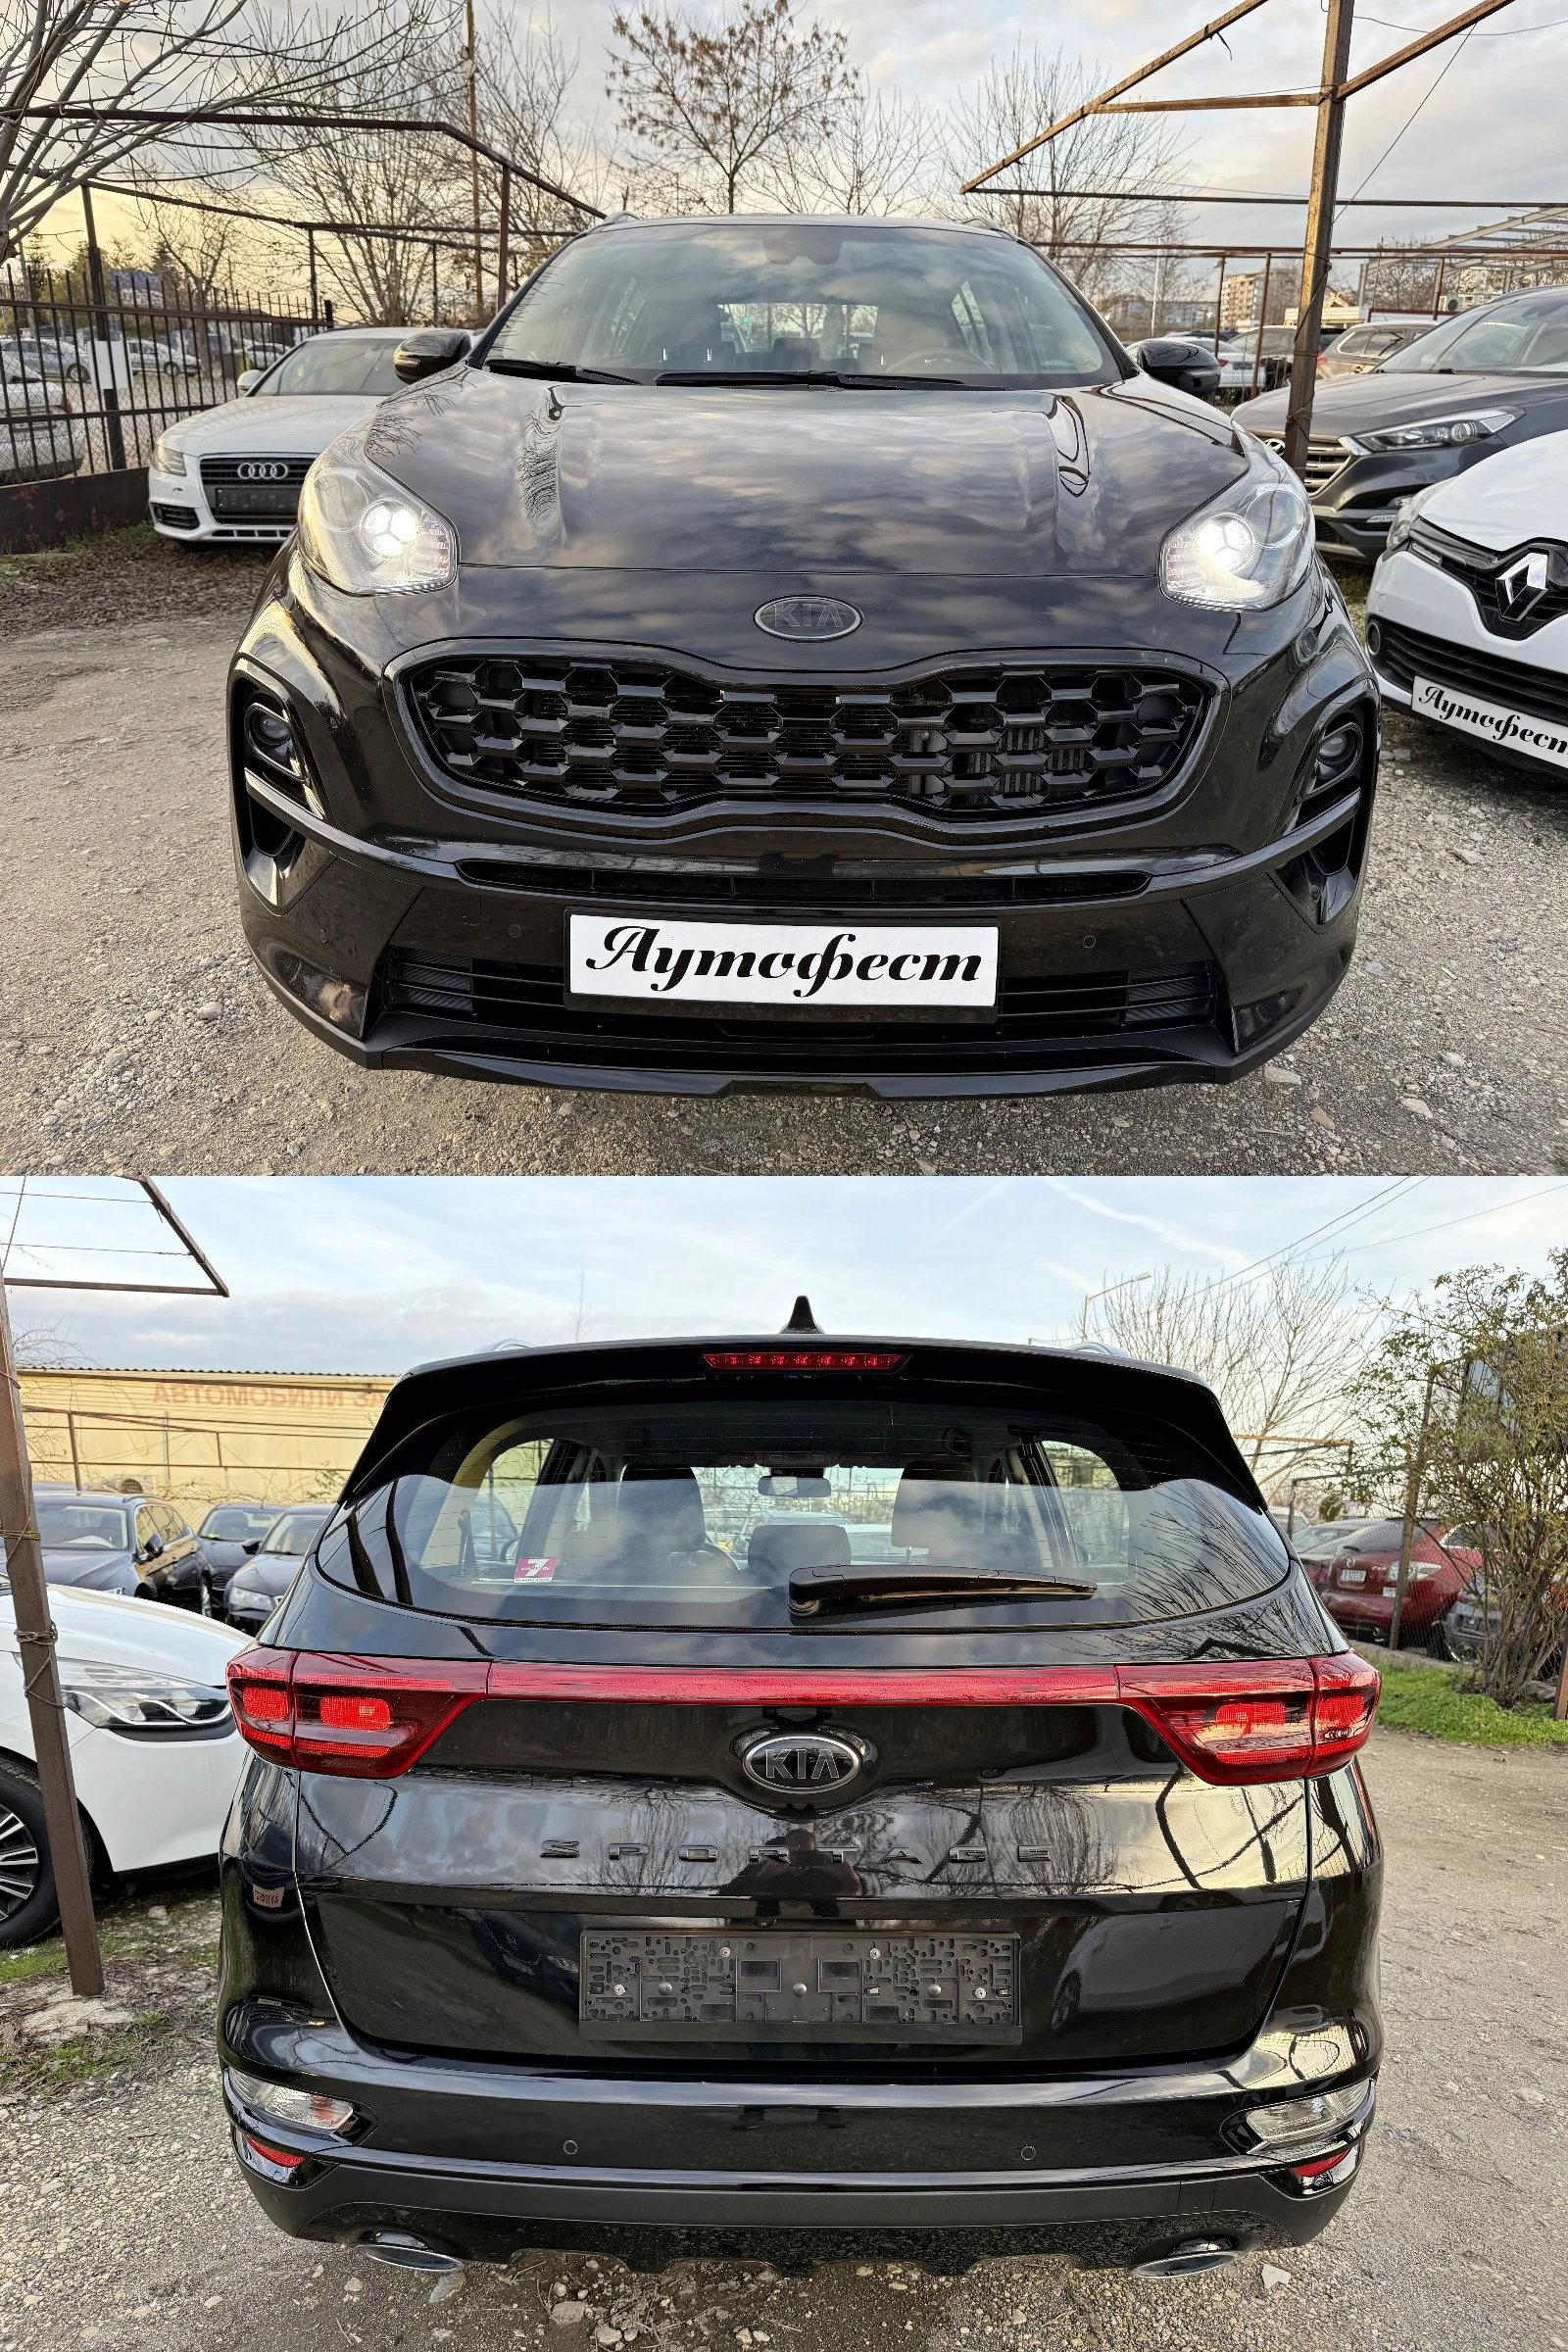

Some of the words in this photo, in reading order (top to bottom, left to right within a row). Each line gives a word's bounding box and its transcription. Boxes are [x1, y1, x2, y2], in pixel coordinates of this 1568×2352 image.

[774, 603, 844, 627] KIA
[586, 925, 982, 998] Аутофест
[153, 1383, 344, 1407] АВТОМОБИЛИ
[765, 1749, 840, 1779] KIA
[539, 1839, 1053, 1864] SPORTAGE
